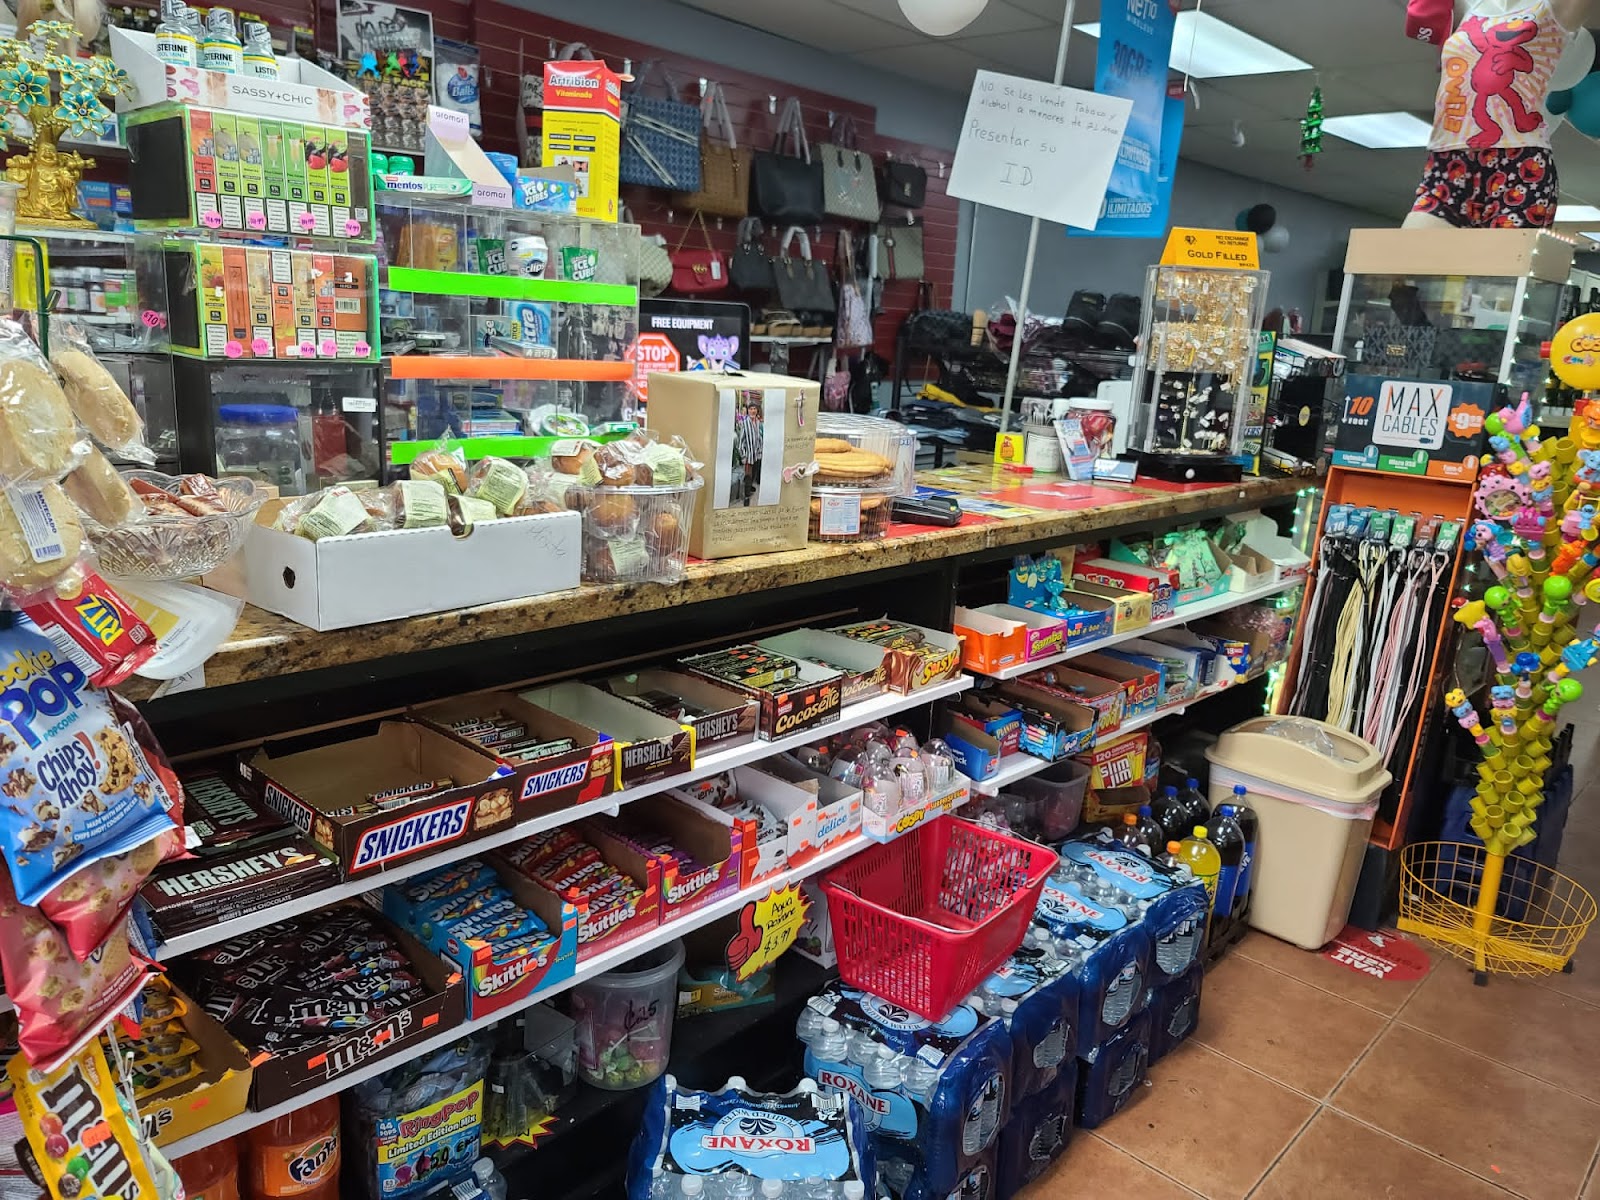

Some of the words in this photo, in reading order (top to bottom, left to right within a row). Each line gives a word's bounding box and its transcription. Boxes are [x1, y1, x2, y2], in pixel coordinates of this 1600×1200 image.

[549, 75, 598, 88] Artribion
[231, 85, 314, 106] SASSY+CHIC
[1443, 57, 1469, 134] ELMO
[435, 111, 465, 124] aromar
[1029, 108, 1065, 125] menores
[1071, 115, 1082, 128] de
[968, 119, 1031, 148] Presentar
[386, 180, 423, 190] mentos
[1000, 162, 1033, 186] ID
[476, 189, 507, 200] aromar
[524, 190, 549, 206] CUBES
[525, 182, 538, 195] ICE
[1107, 203, 1153, 214] ILIMITADOS
[573, 261, 589, 271] ICE
[1187, 249, 1214, 259] GOLD
[1215, 251, 1248, 261] FILLED
[651, 315, 672, 329] FREE
[671, 317, 714, 330] EQUIPMENT
[637, 345, 670, 361] STOP
[1349, 396, 1375, 416] 10
[1385, 384, 1444, 418] MAX
[1347, 418, 1369, 426] FOOT
[1382, 414, 1439, 437] CABLES
[74, 593, 125, 647] RITZ
[1030, 630, 1063, 656] Samba
[920, 650, 958, 686] Susy
[0, 660, 87, 750] POP
[775, 686, 841, 735] Cocosette
[43, 711, 80, 742] POPCORN
[996, 720, 1020, 740] PLANTERS
[1095, 751, 1112, 763] 120
[1111, 741, 1135, 754] ORIGINAL
[37, 740, 86, 792] Chips
[1100, 756, 1130, 778] slim
[524, 762, 587, 797] SNICKERS
[1110, 768, 1132, 788] jim
[376, 781, 433, 799] SNICKERS
[73, 831, 91, 841] CHIPS
[106, 811, 125, 828] COOKIE
[123, 797, 138, 814] PIECES
[86, 817, 102, 829] MADE
[101, 808, 116, 822] WITH
[114, 800, 128, 813] REAL
[265, 785, 312, 832] SNICKERS
[359, 804, 468, 865] SNICKERS
[817, 814, 848, 838] delice
[157, 847, 305, 897] HERSHEY'S
[1087, 851, 1150, 883] ROXANE
[668, 869, 721, 904] Skittles
[242, 905, 257, 915] MILK
[257, 895, 292, 910] CHOCOLATE
[577, 905, 636, 944] Skittles
[1330, 953, 1384, 980] WAIT
[1337, 946, 1394, 974] HERE
[821, 1071, 886, 1113] ROXANE
[718, 1109, 752, 1126] WATER
[751, 1110, 798, 1129] PURIFIED
[816, 1111, 838, 1121] 24
[387, 1137, 426, 1159] Limited
[427, 1120, 460, 1141] Edition
[459, 1114, 477, 1128] Mix
[708, 1136, 811, 1152] ROXANE
[289, 1137, 337, 1182] Fanta
